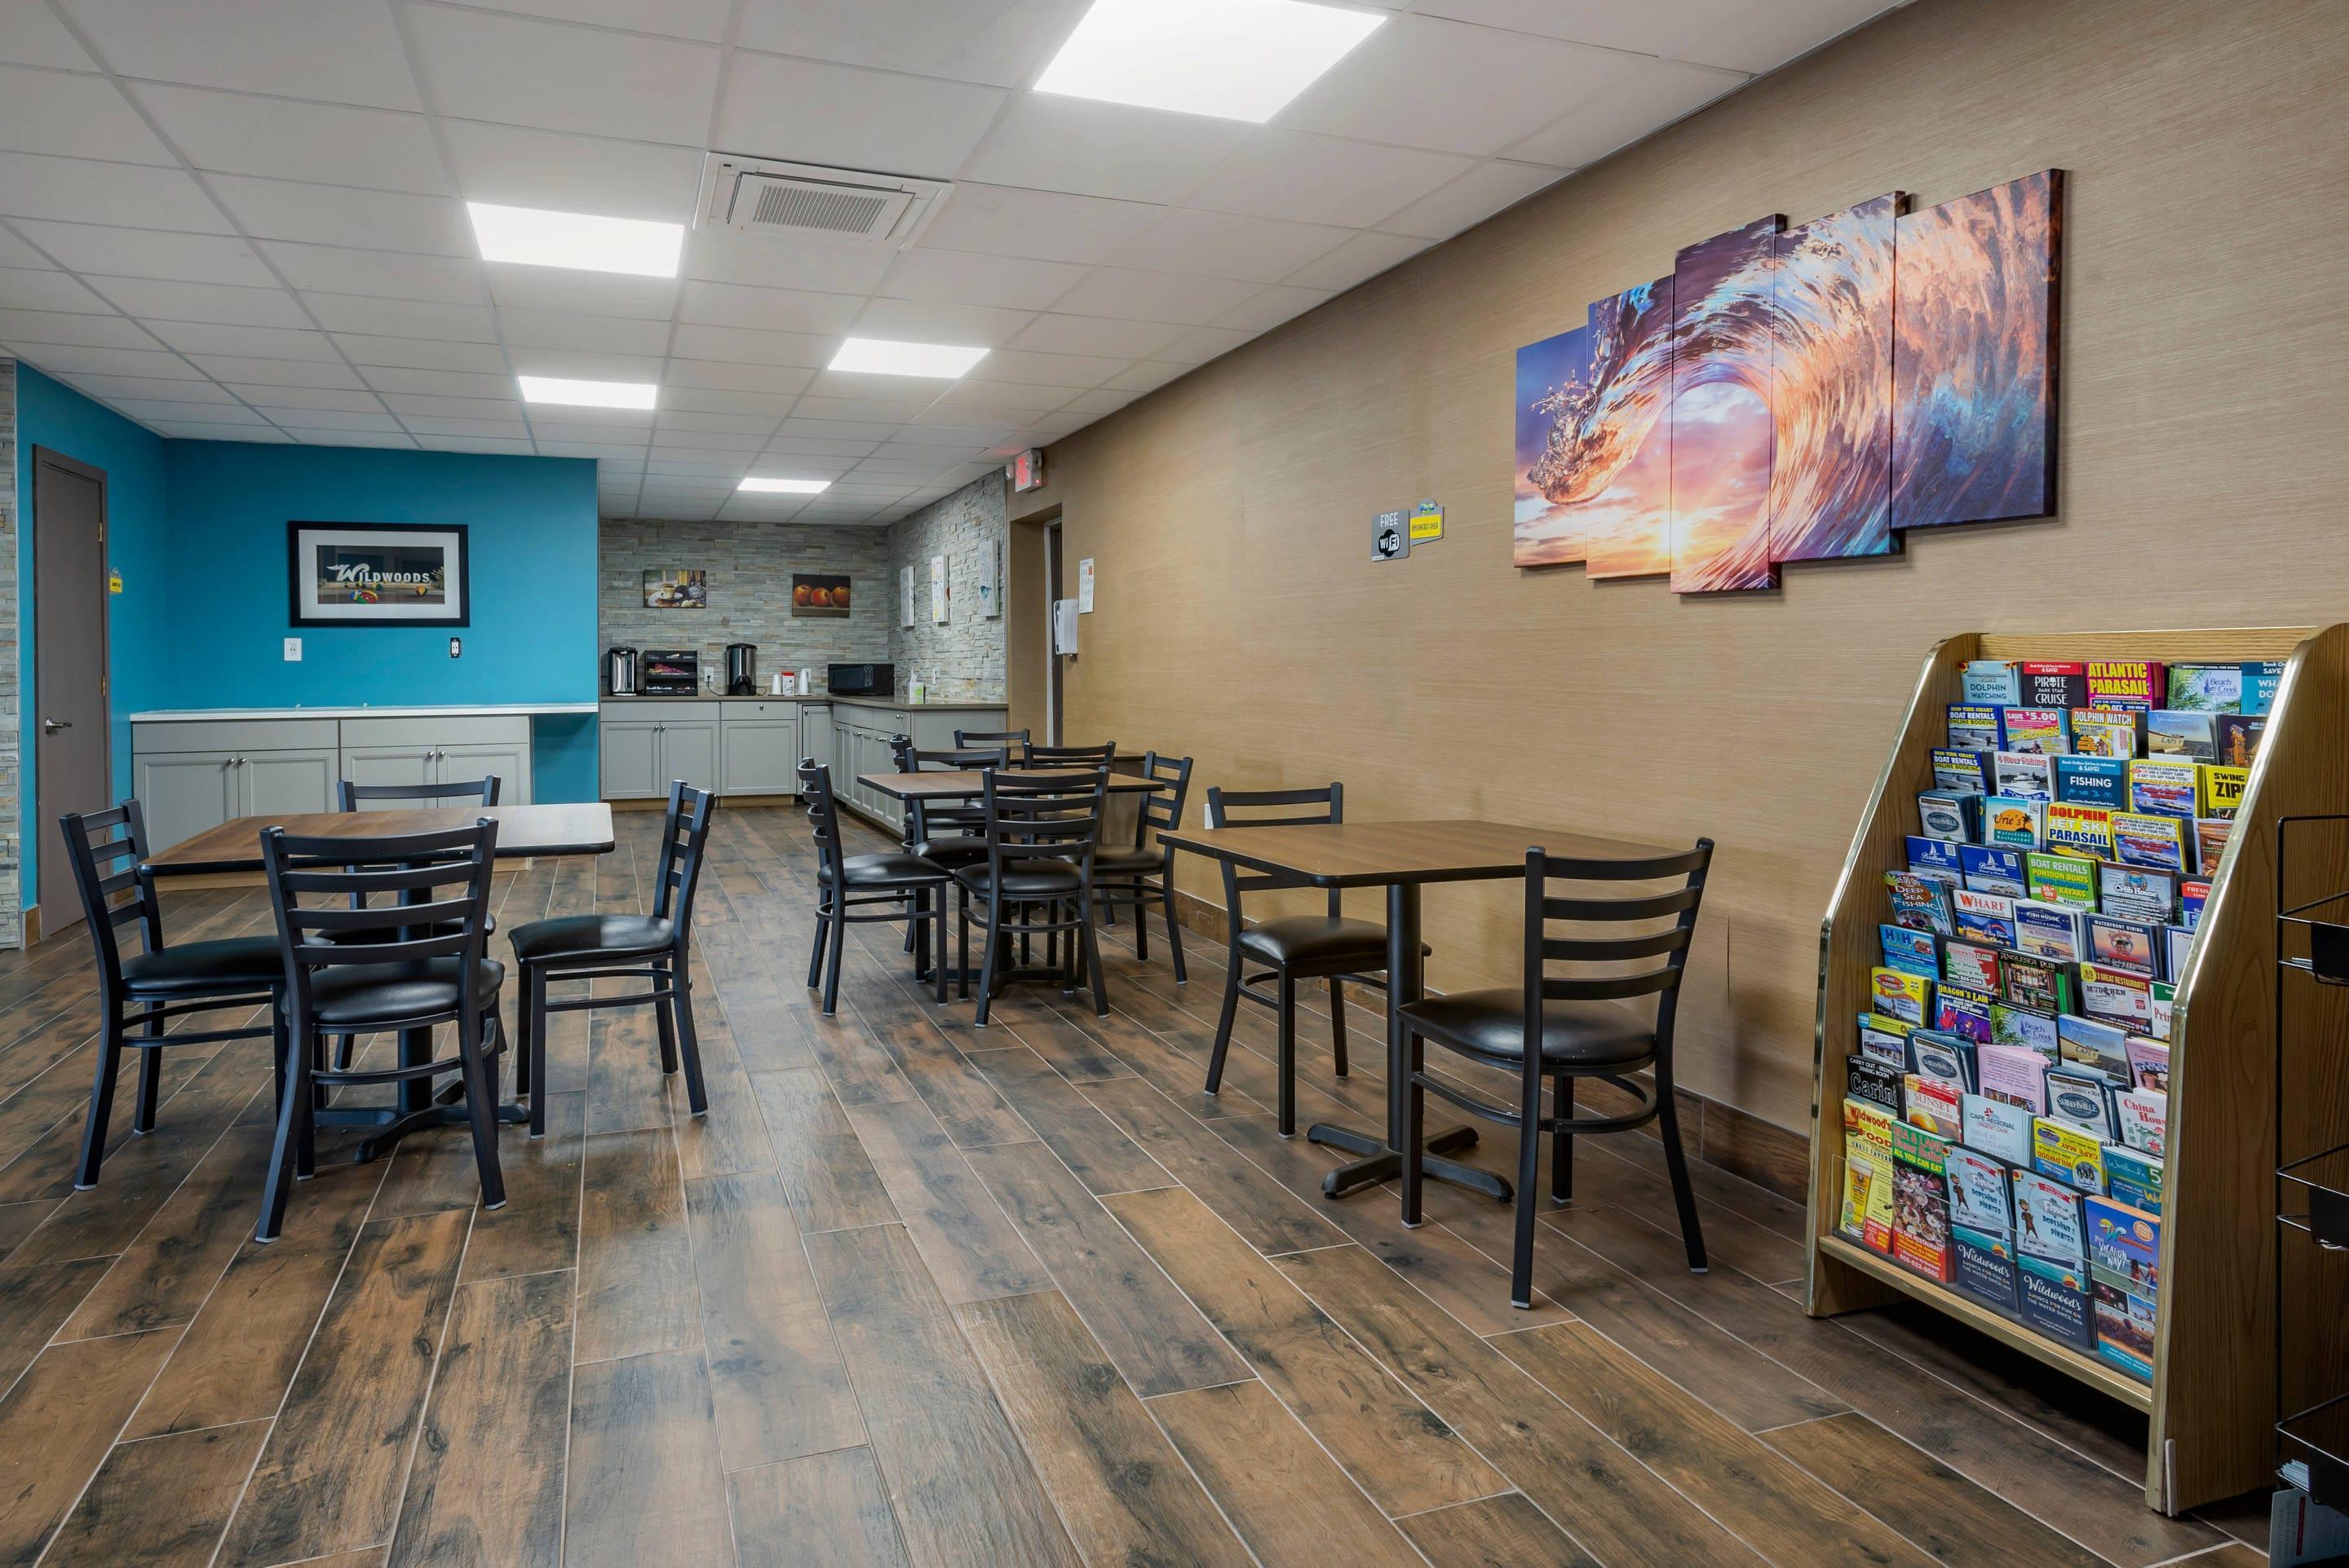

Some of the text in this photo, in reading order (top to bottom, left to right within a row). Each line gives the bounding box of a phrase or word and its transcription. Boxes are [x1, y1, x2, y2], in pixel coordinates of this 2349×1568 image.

[1380, 512, 1398, 528] FREE
[2088, 662, 2148, 678] ATLANTIC
[1970, 683, 2006, 691] DOLPHIN
[2089, 679, 2149, 695] PARASAIL
[2035, 693, 2068, 704] CRUISE
[2025, 711, 2057, 721] $5.00
[2074, 711, 2132, 725] DOLPHIN WATCH
[1951, 757, 1978, 766] RENTALS
[1955, 763, 1980, 771] BOOKING
[2021, 757, 2046, 766] Fishing
[2070, 776, 2112, 788] FISHING
[2214, 781, 2245, 798] ZIP
[1993, 813, 2021, 825] Urie's
[2050, 806, 2108, 822] DOLPHIN
[2049, 817, 2108, 833] JET SKI
[2049, 828, 2108, 846] PARASAIL
[2031, 859, 2088, 874] BOAT RENTALS
[2033, 868, 2089, 883] PONTOON BOATS
[1895, 886, 1923, 894] DEEP
[2059, 887, 2086, 898] KAYAKS
[2114, 884, 2157, 897] Crab House
[2187, 886, 2209, 894] FRESH
[1892, 897, 1940, 910] FISHING
[1959, 893, 2006, 911] WHARF
[2041, 913, 2059, 921] HOUSE
[2095, 920, 2125, 930] WATERFRONT
[1999, 952, 2037, 966] ANGLESEA
[2039, 961, 2055, 970] PUB
[1938, 984, 1988, 1003] DRAGON'S LAIR
[2154, 1007, 2171, 1022] Prin
[2024, 1021, 2046, 1032] Beach
[1849, 1058, 1865, 1067] CARRY
[1866, 1062, 1876, 1070] OUT
[1859, 1067, 1890, 1079] DINING ROOM
[1850, 1072, 1898, 1108] Carini
[1914, 1093, 1950, 1112] SUNSET
[2123, 1099, 2156, 1114] China
[1850, 1105, 1891, 1131] Wildwood's
[1970, 1112, 2015, 1129] CAPE REGIONAL
[2139, 1111, 2166, 1125] Hous
[1977, 1122, 1996, 1131] URGENT
[1858, 1128, 1891, 1147] FOOD
[2061, 1142, 2098, 1160] CAPE MAY
[1893, 1148, 1943, 1173] ALL YOU CAN EAT
[2037, 1151, 2073, 1168] WILDWOOD
[1979, 1200, 2002, 1214] PIRATES
[2050, 1228, 2075, 1243] PIRATES
[1913, 1235, 1944, 1253] RESTAURANT
[2099, 1239, 2127, 1261] VACATION
[1958, 1244, 2011, 1278] Wildwood's
[1962, 1260, 1982, 1271] SOURCE
[1992, 1273, 2002, 1281] FUN
[1971, 1269, 1988, 1279] WATER
[1988, 1276, 2002, 1286] SINCE
[2024, 1274, 2082, 1311] Wildwood's
[2027, 1296, 2072, 1321] THE WATER SINCE
[2028, 1292, 2049, 1304] SOURCE
[2050, 1301, 2060, 1310] FOR
[2061, 1306, 2073, 1314] FUN
